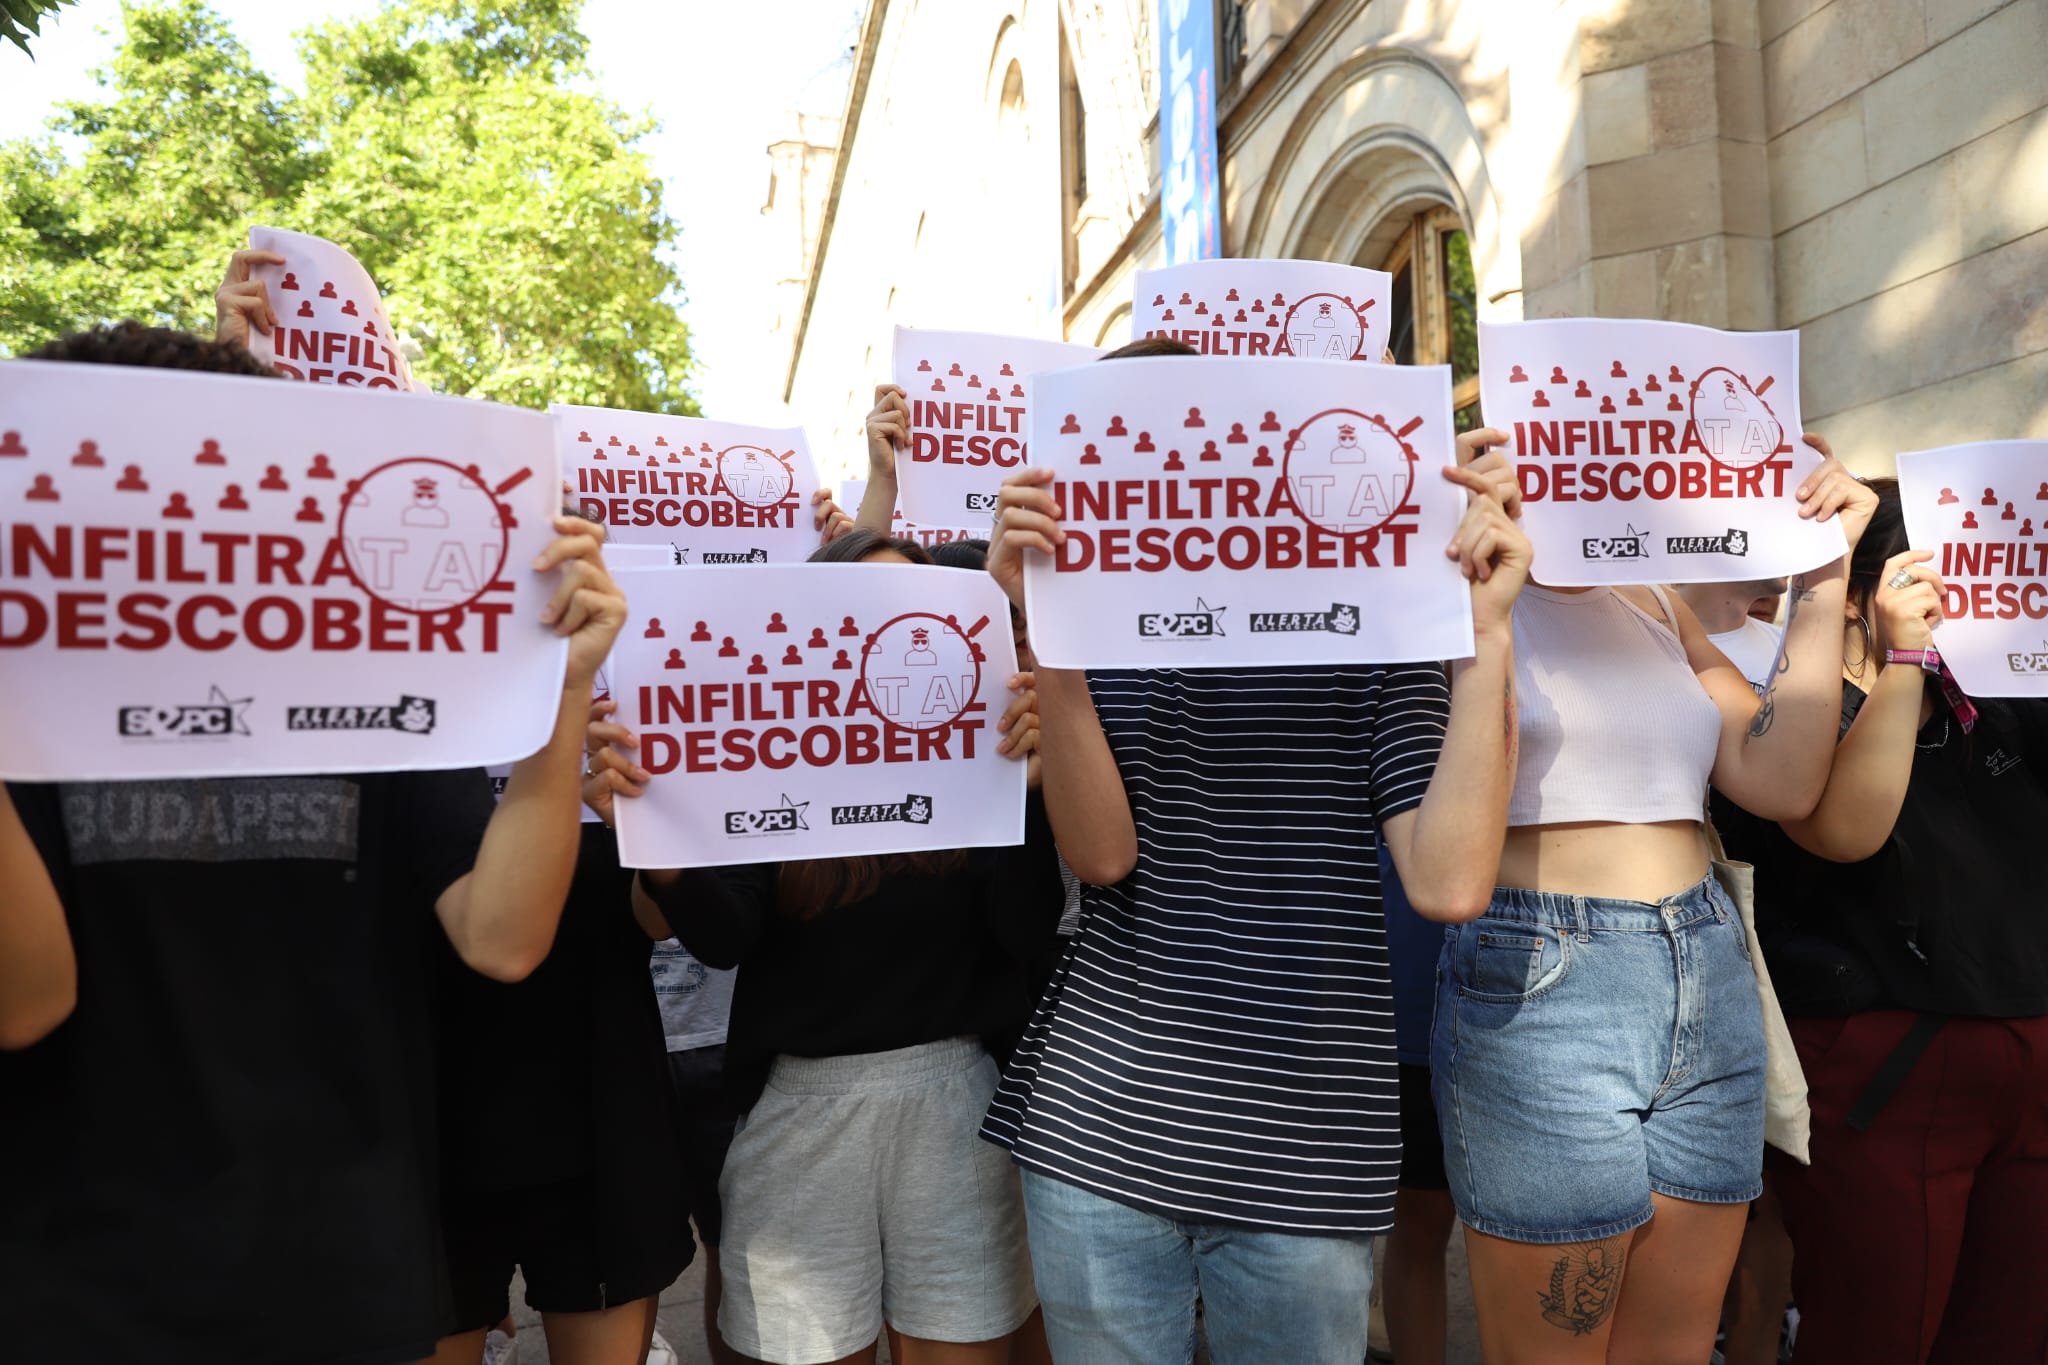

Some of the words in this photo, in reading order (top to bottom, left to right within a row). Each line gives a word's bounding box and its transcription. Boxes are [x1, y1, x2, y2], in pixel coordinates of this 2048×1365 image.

[913, 399, 1026, 433] INFILT
[912, 432, 1028, 468] DESC
[1516, 460, 1793, 503] DESCOBERT
[579, 497, 800, 529] DESCOBERT
[0, 522, 407, 592] NFILTRAT
[1055, 523, 1419, 573] DESCOBERT
[1670, 537, 1723, 549] ALERTA
[0, 589, 515, 654] DESCOBERT
[1253, 613, 1327, 628] ALERTA
[292, 706, 391, 726] ALERTA
[640, 719, 986, 775] DESCOBERT
[65, 791, 356, 845] BUDAPEST
[835, 803, 902, 819] ALERTA
